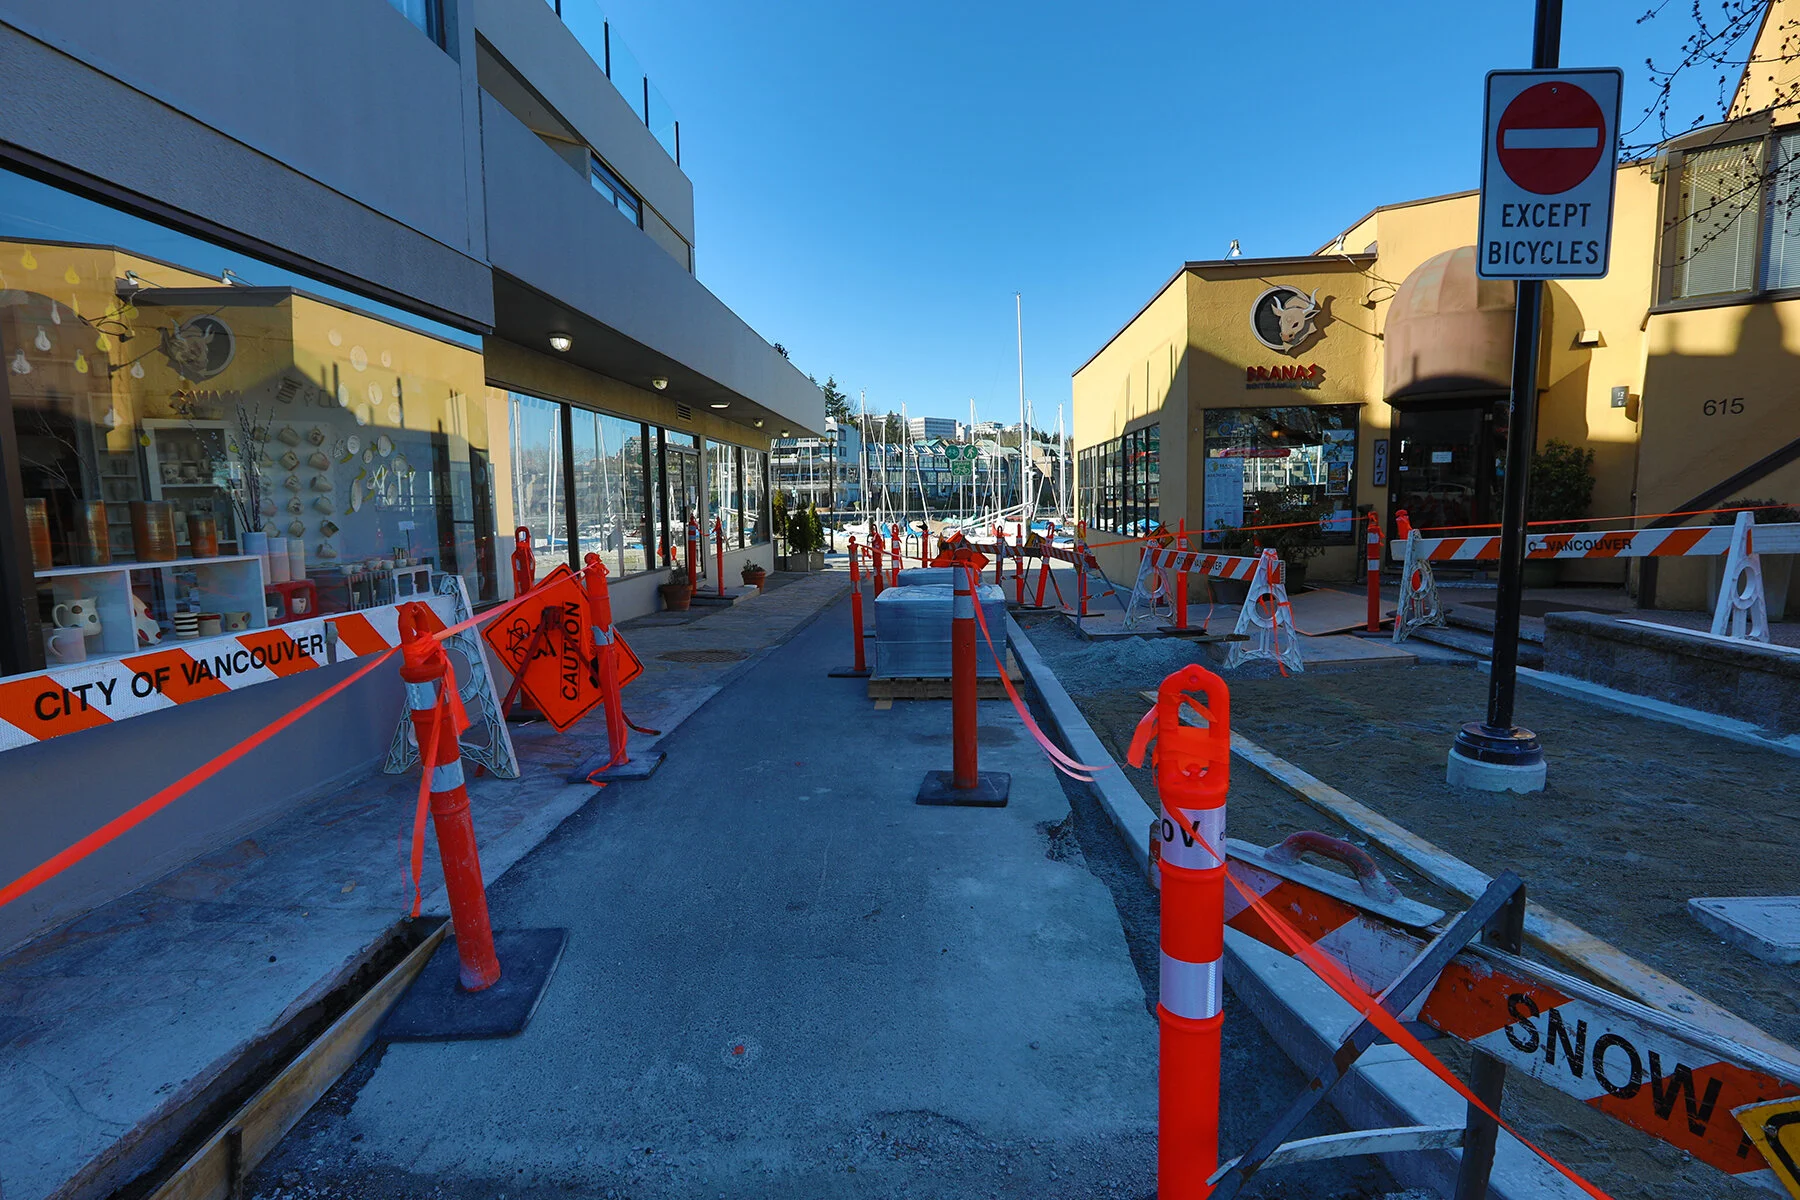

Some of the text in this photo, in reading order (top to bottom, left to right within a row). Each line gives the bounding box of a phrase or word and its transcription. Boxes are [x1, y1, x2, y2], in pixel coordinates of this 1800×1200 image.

[1501, 202, 1591, 228] EXCEPT
[1487, 240, 1599, 265] BICYCLES
[1246, 363, 1318, 382] BRANAS
[1703, 397, 1745, 416] 615
[1375, 444, 1385, 483] 617
[1547, 538, 1632, 552] VANCOUVER
[562, 601, 580, 701] CAUTION
[34, 633, 323, 721] CITY OF VANCOUVER
[1504, 993, 1723, 1138] SNOW
